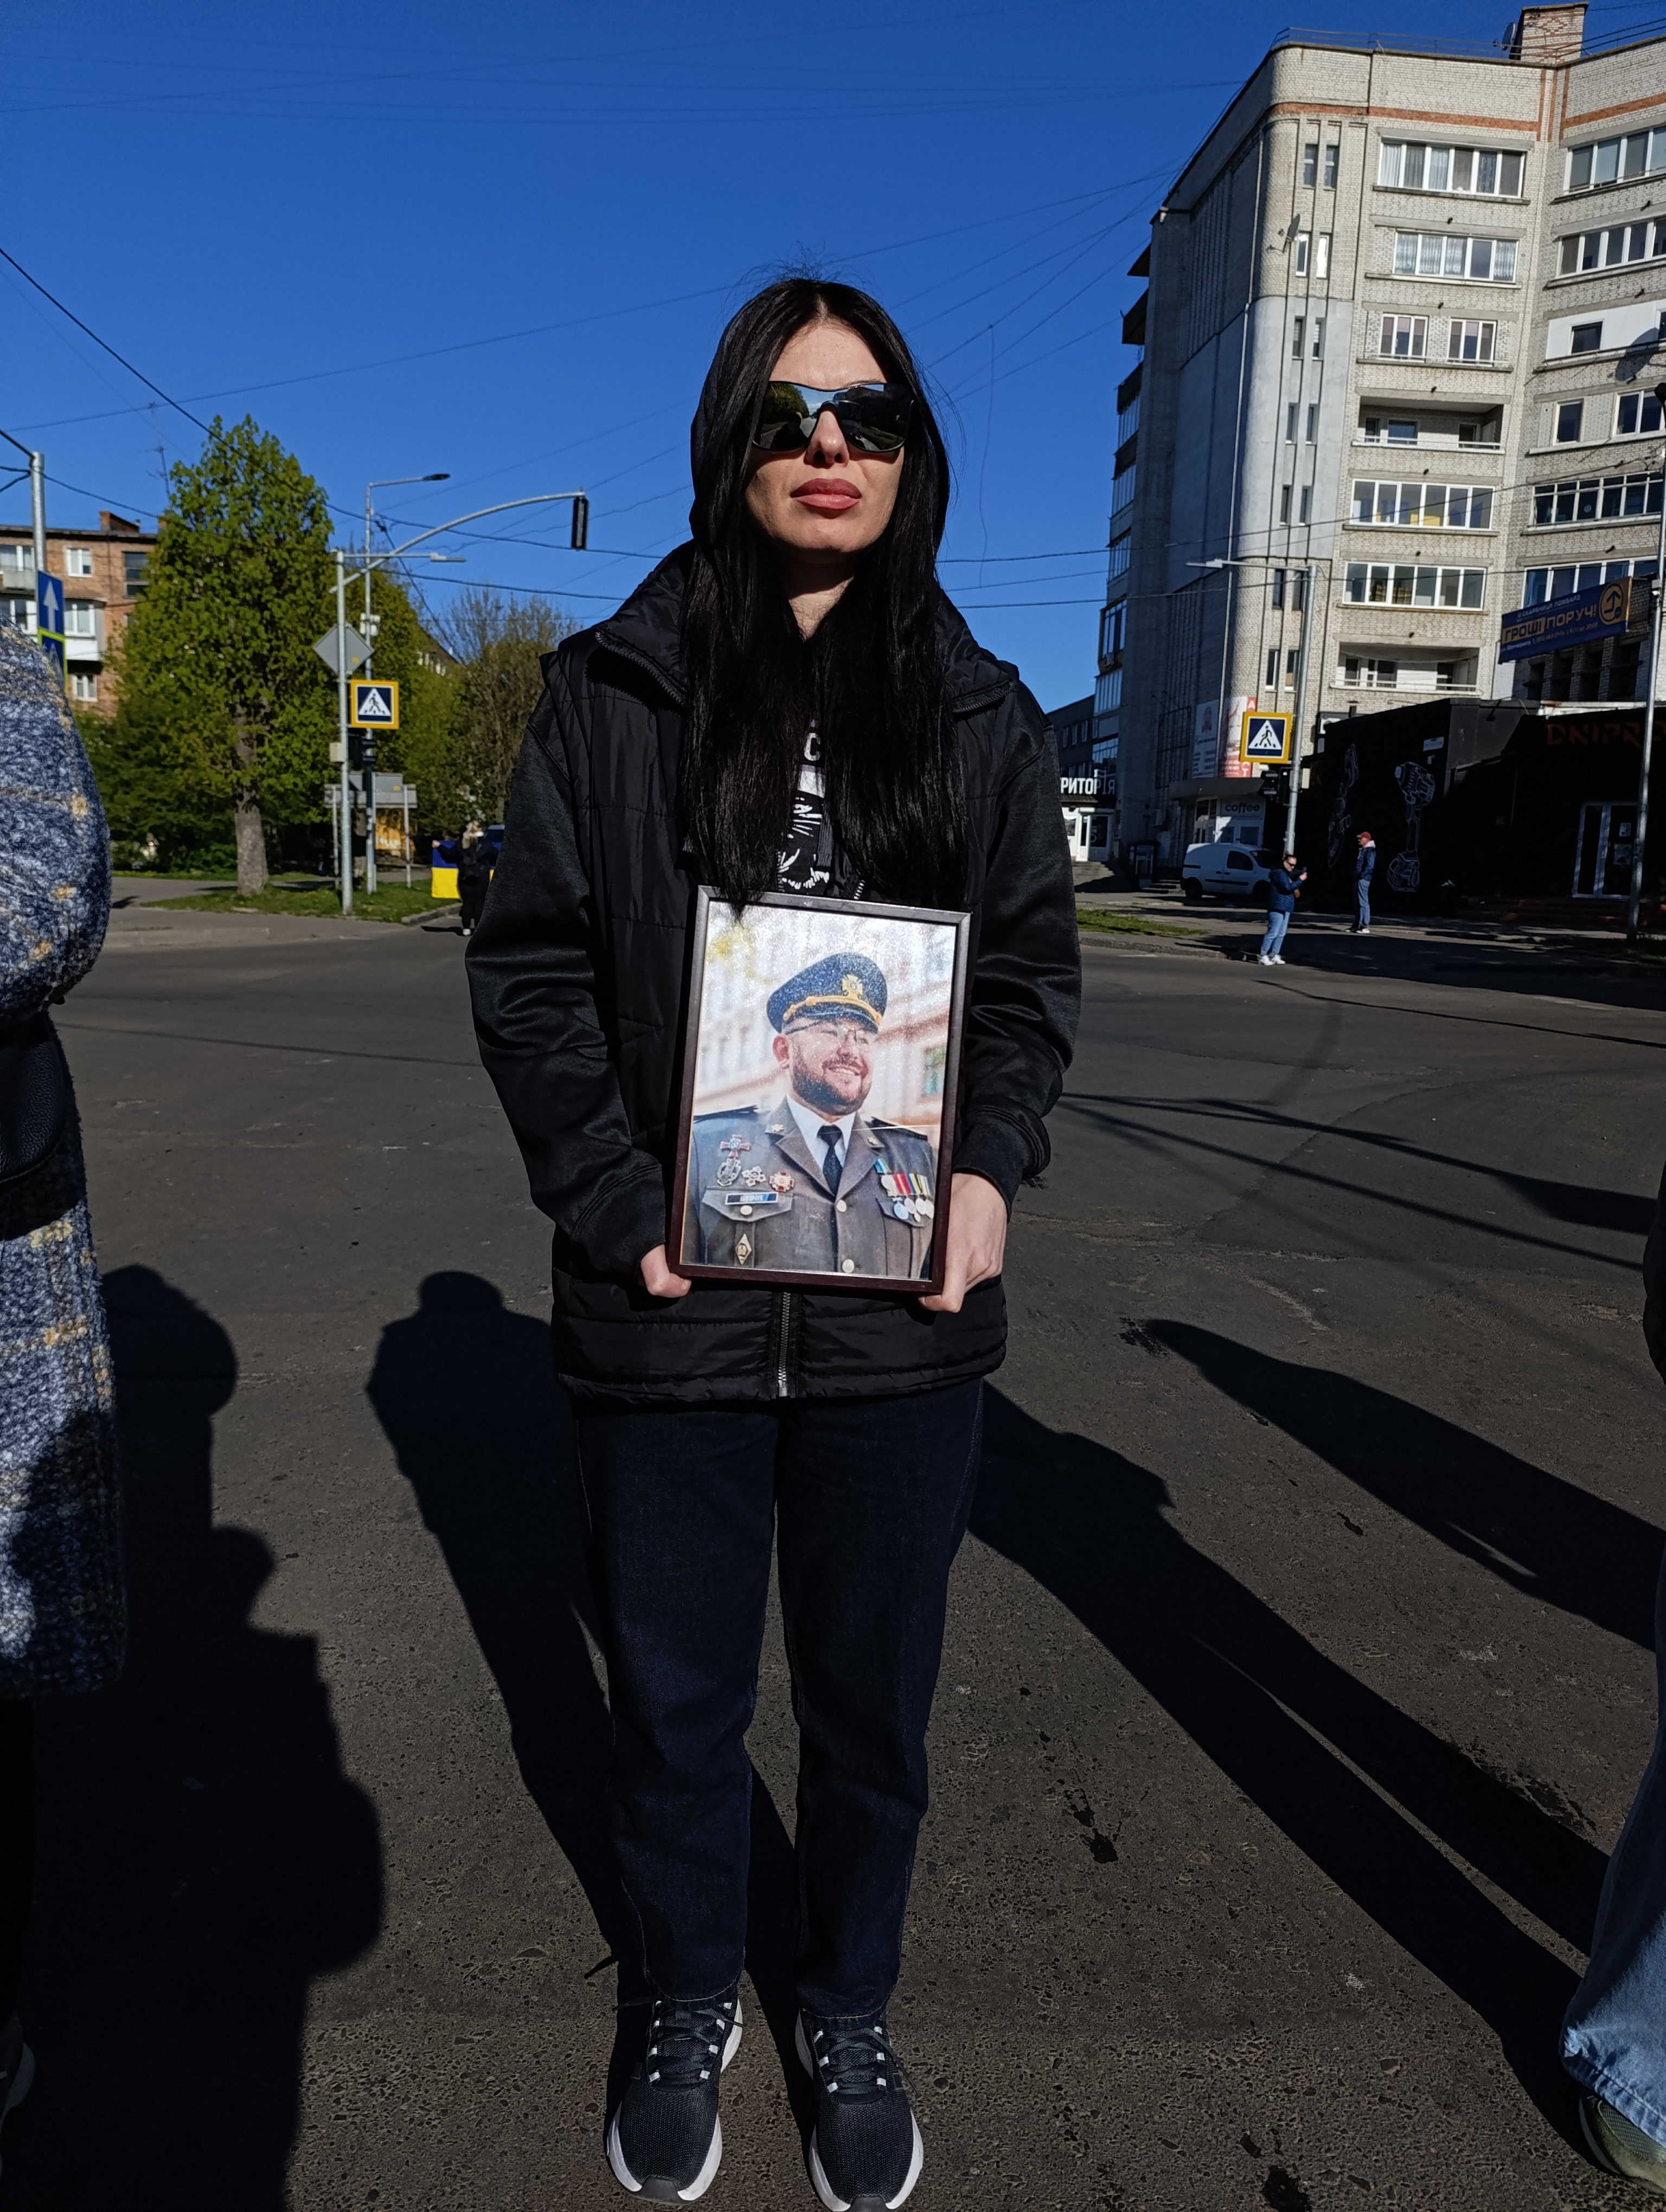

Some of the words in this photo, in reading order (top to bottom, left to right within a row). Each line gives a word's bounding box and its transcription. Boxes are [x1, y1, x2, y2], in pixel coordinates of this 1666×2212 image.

[1505, 621, 1542, 641] ГРОШІ
[1546, 605, 1597, 629] ПОРУЧ!
[1060, 775, 1116, 795] РИТОРІЯ
[1225, 802, 1260, 813] coffee
